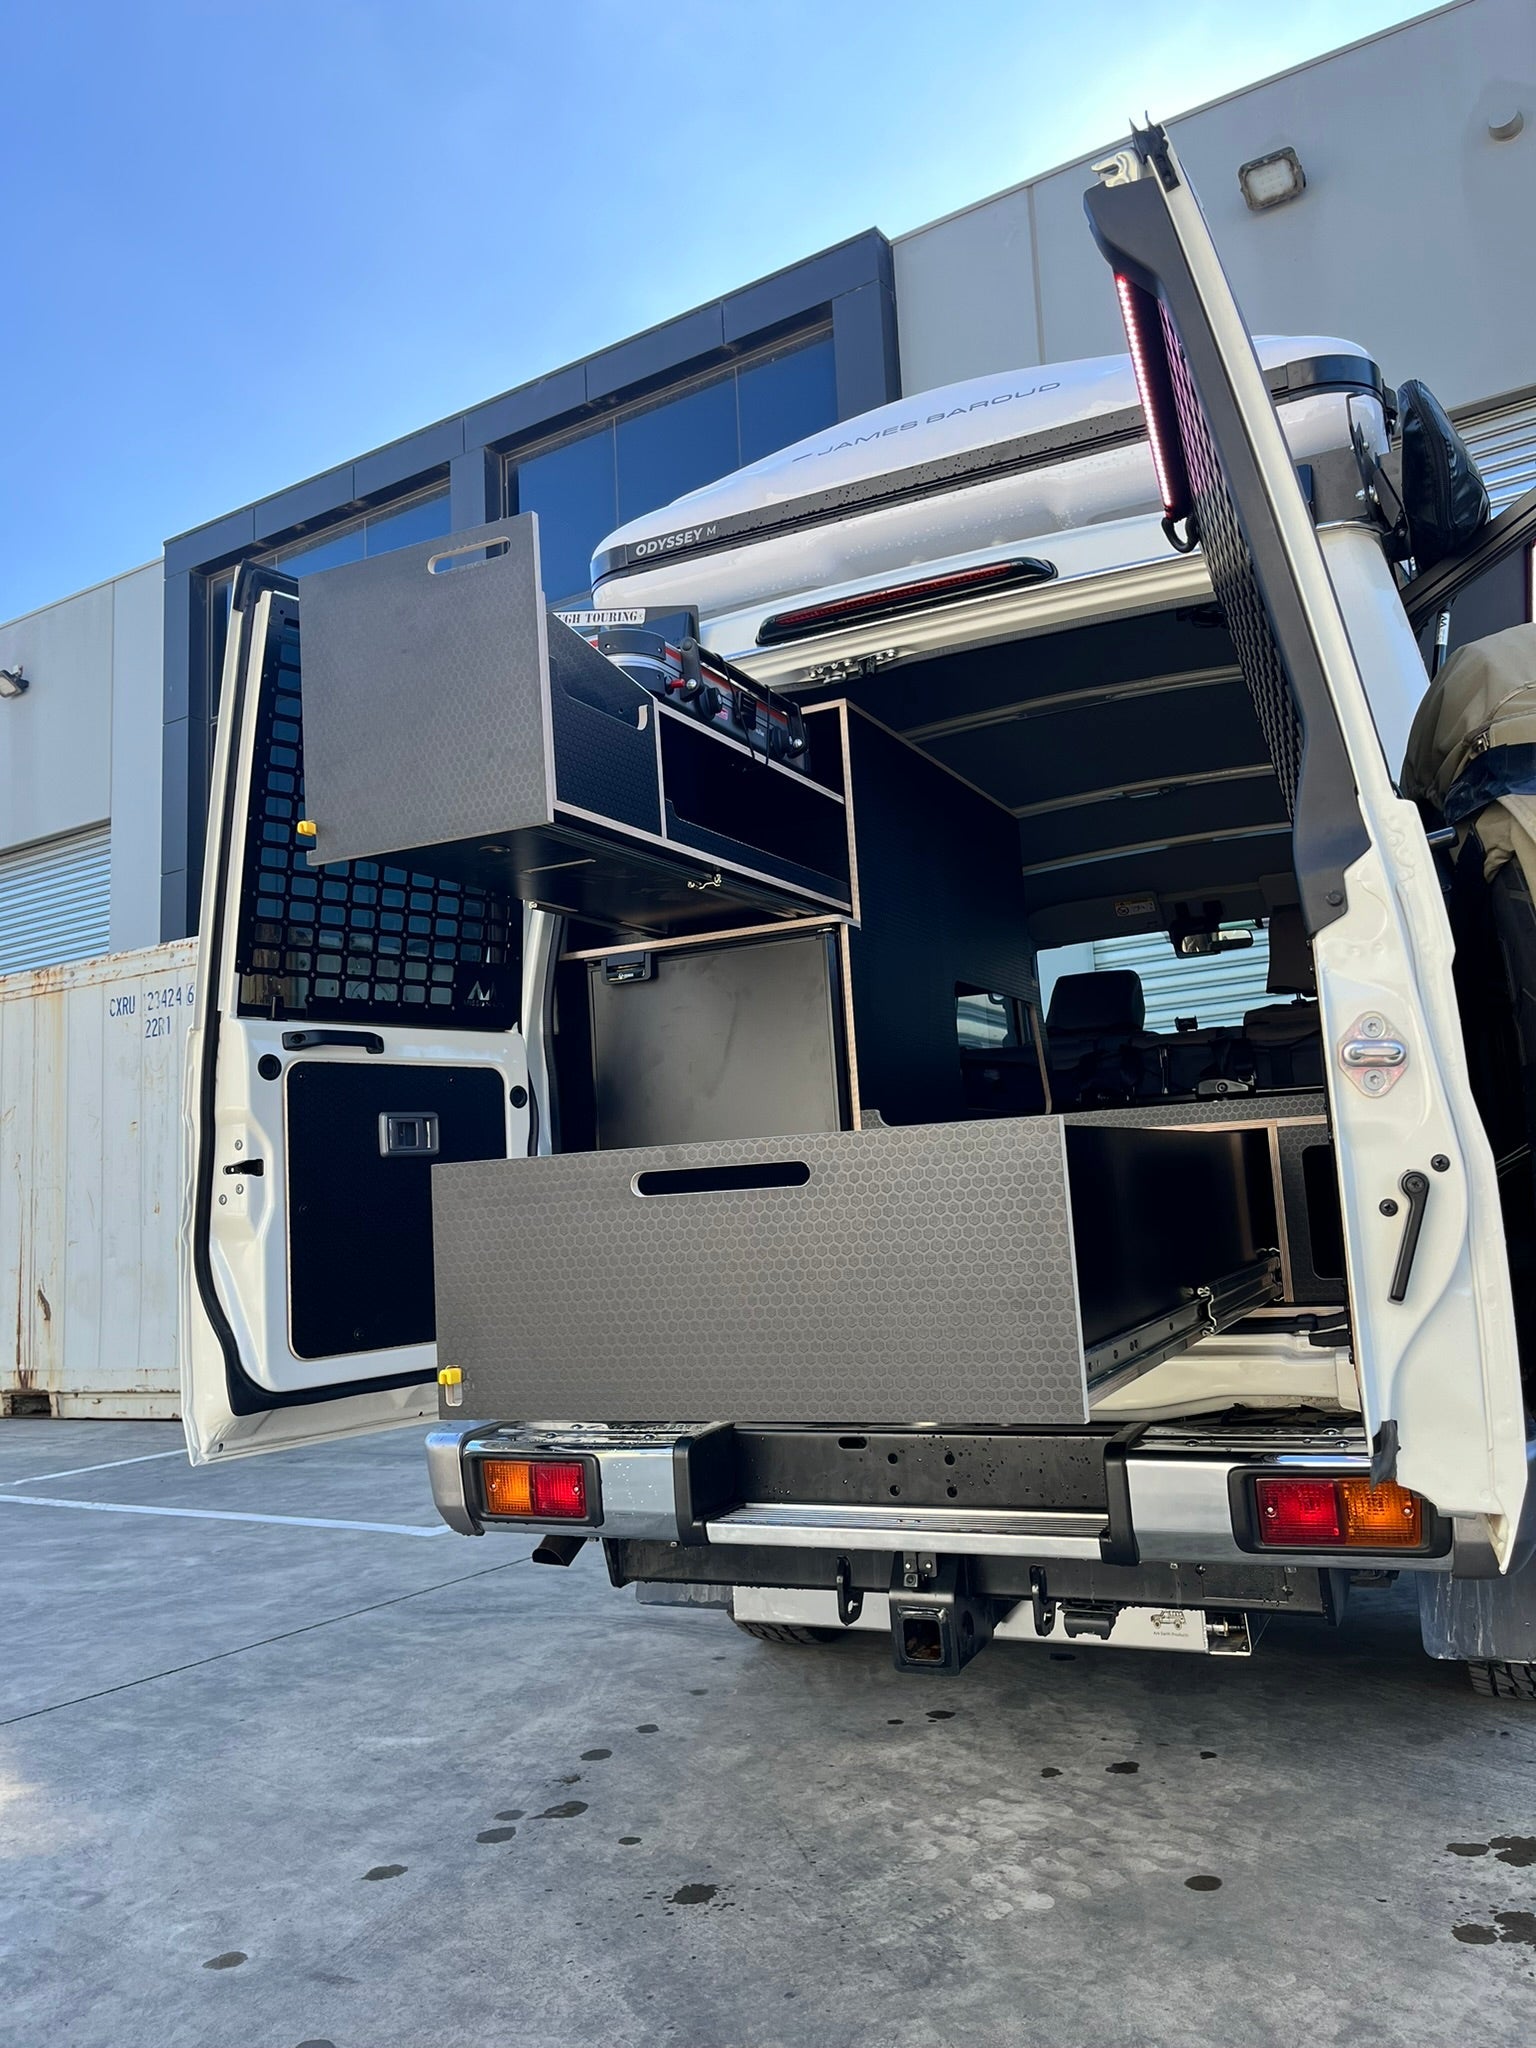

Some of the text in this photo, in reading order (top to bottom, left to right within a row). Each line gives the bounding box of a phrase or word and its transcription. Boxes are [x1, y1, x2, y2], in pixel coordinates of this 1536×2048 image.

[818, 382, 1061, 457] JAMES BAROUD
[635, 525, 717, 557] ODYSSEY M
[585, 611, 638, 624] TOURING
[109, 985, 195, 1017] CXRU 23424 6
[145, 1015, 171, 1039] 22R1
